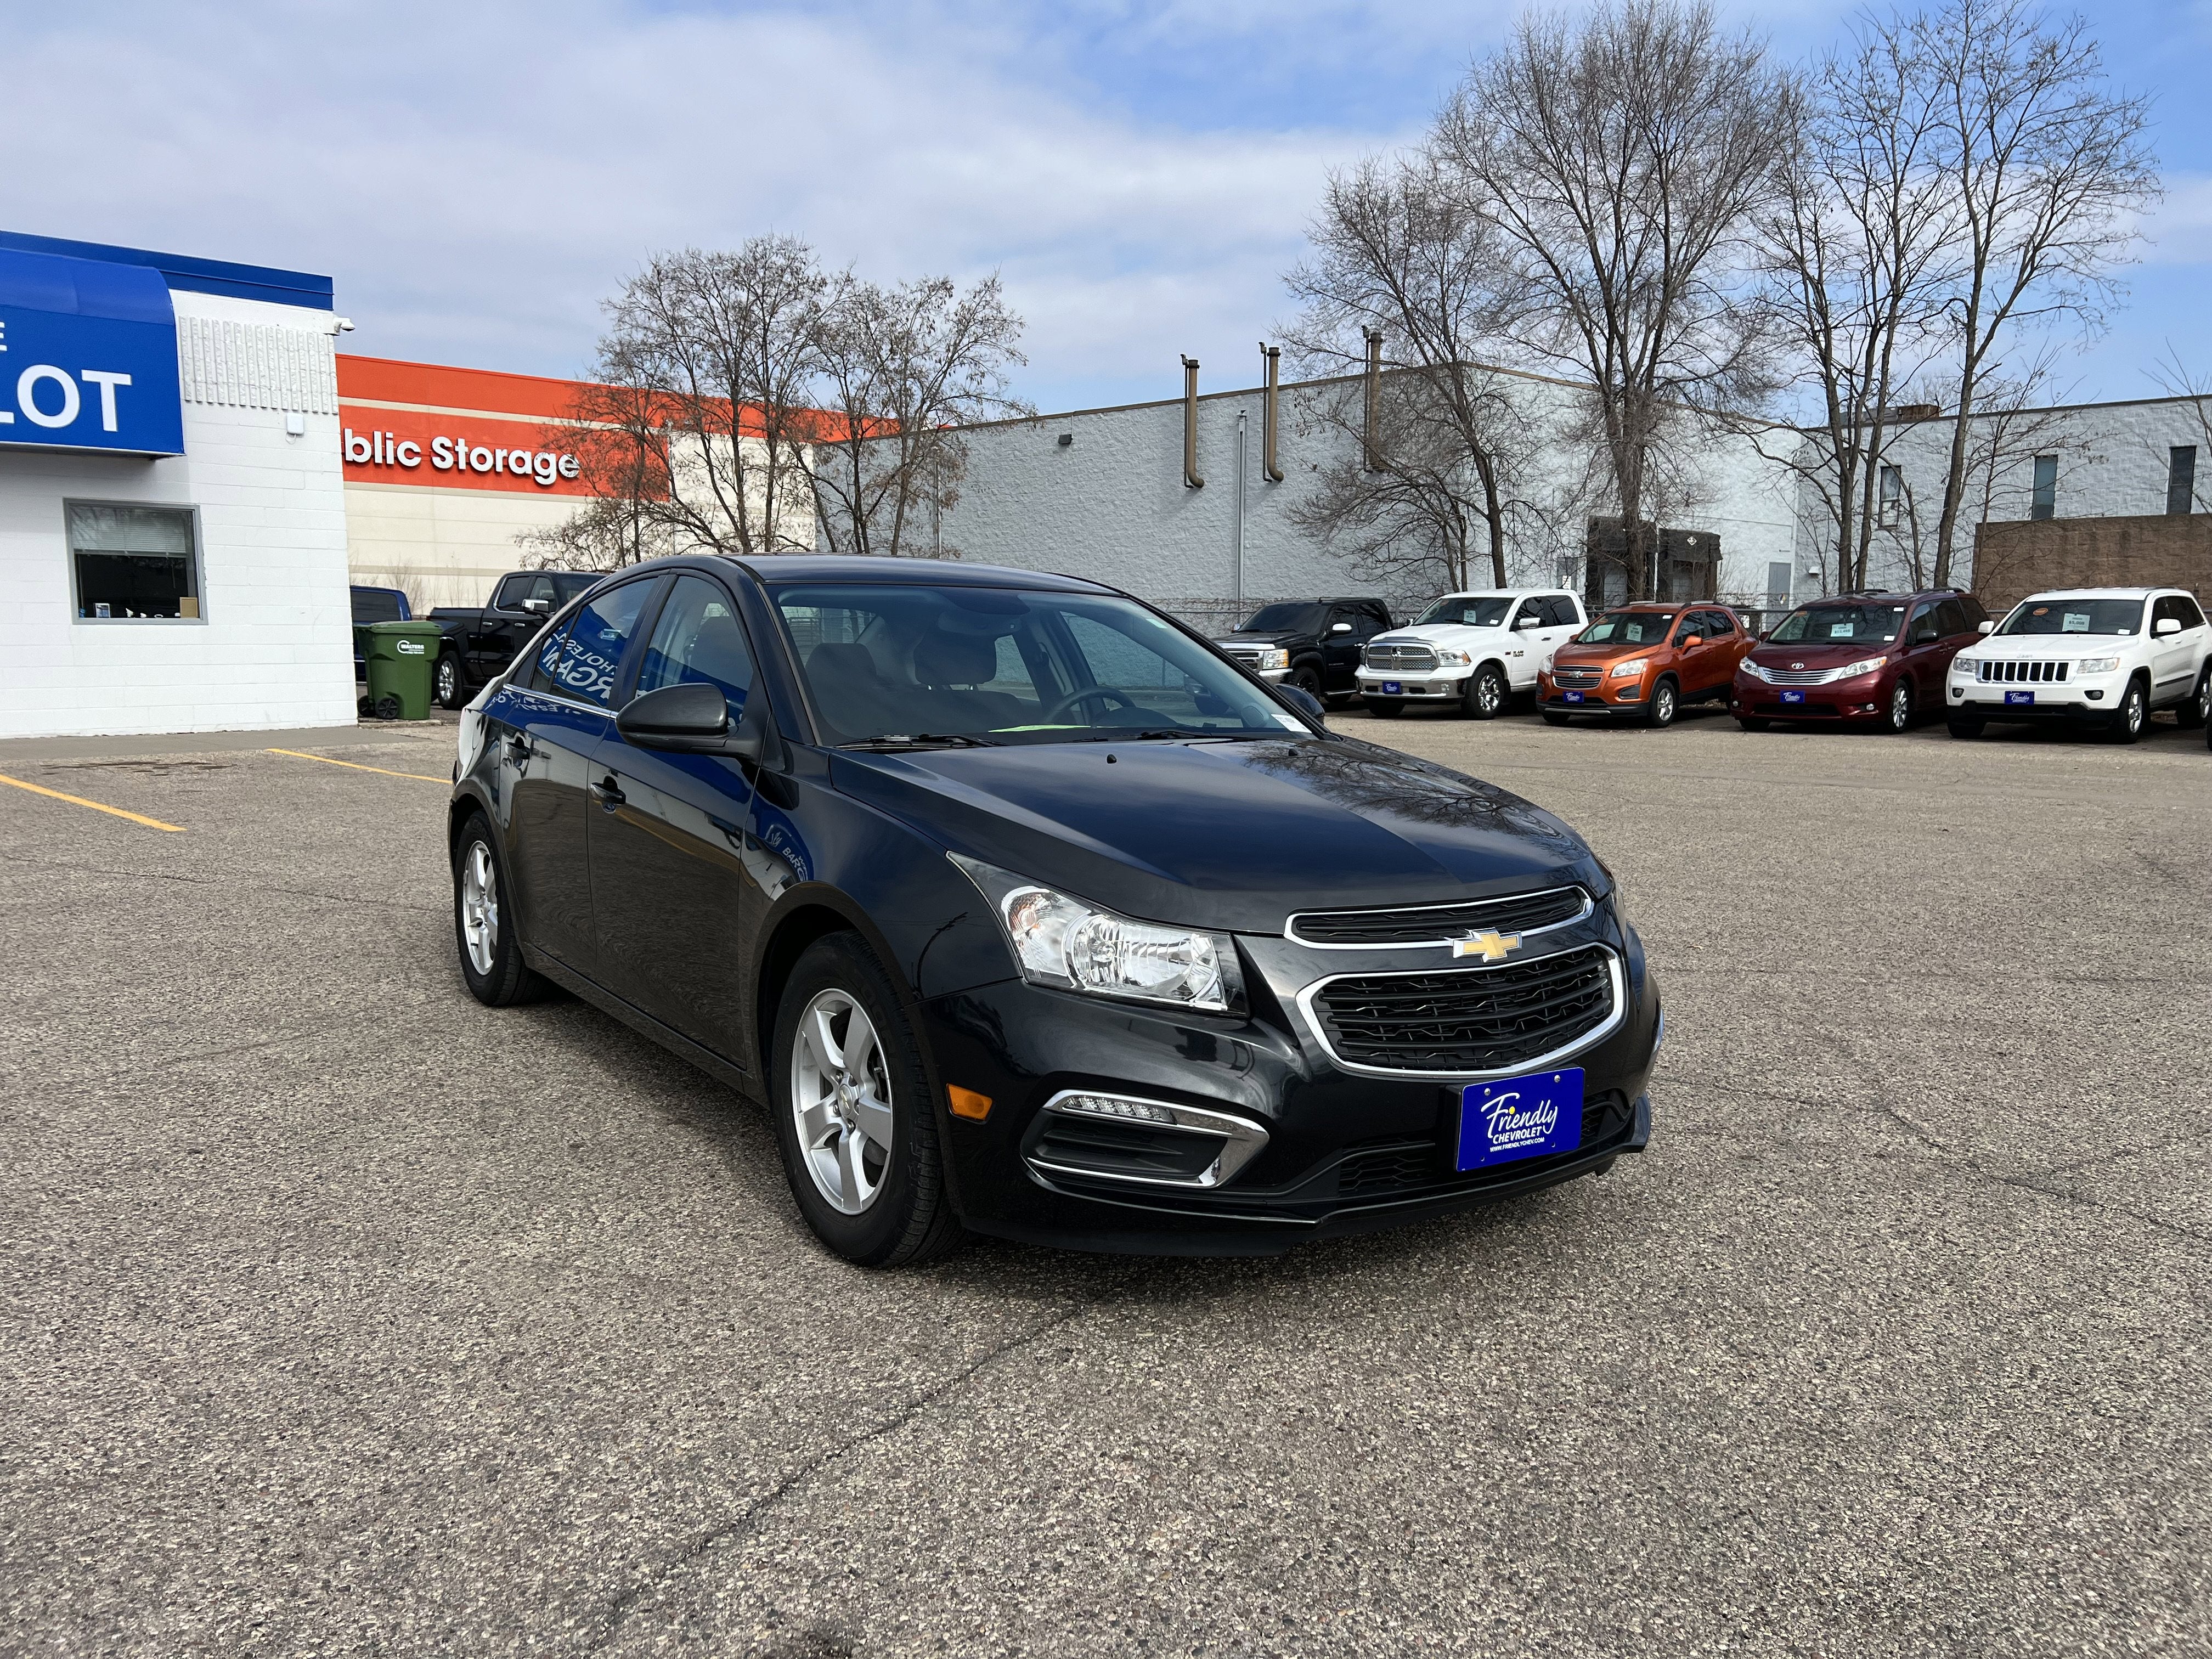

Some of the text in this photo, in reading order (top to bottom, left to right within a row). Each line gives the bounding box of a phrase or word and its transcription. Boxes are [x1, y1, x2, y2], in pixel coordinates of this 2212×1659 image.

[343, 428, 580, 485] blic Storage
[1481, 1092, 1558, 1138] Friendly
[1493, 1126, 1542, 1144] CHEVROLET
